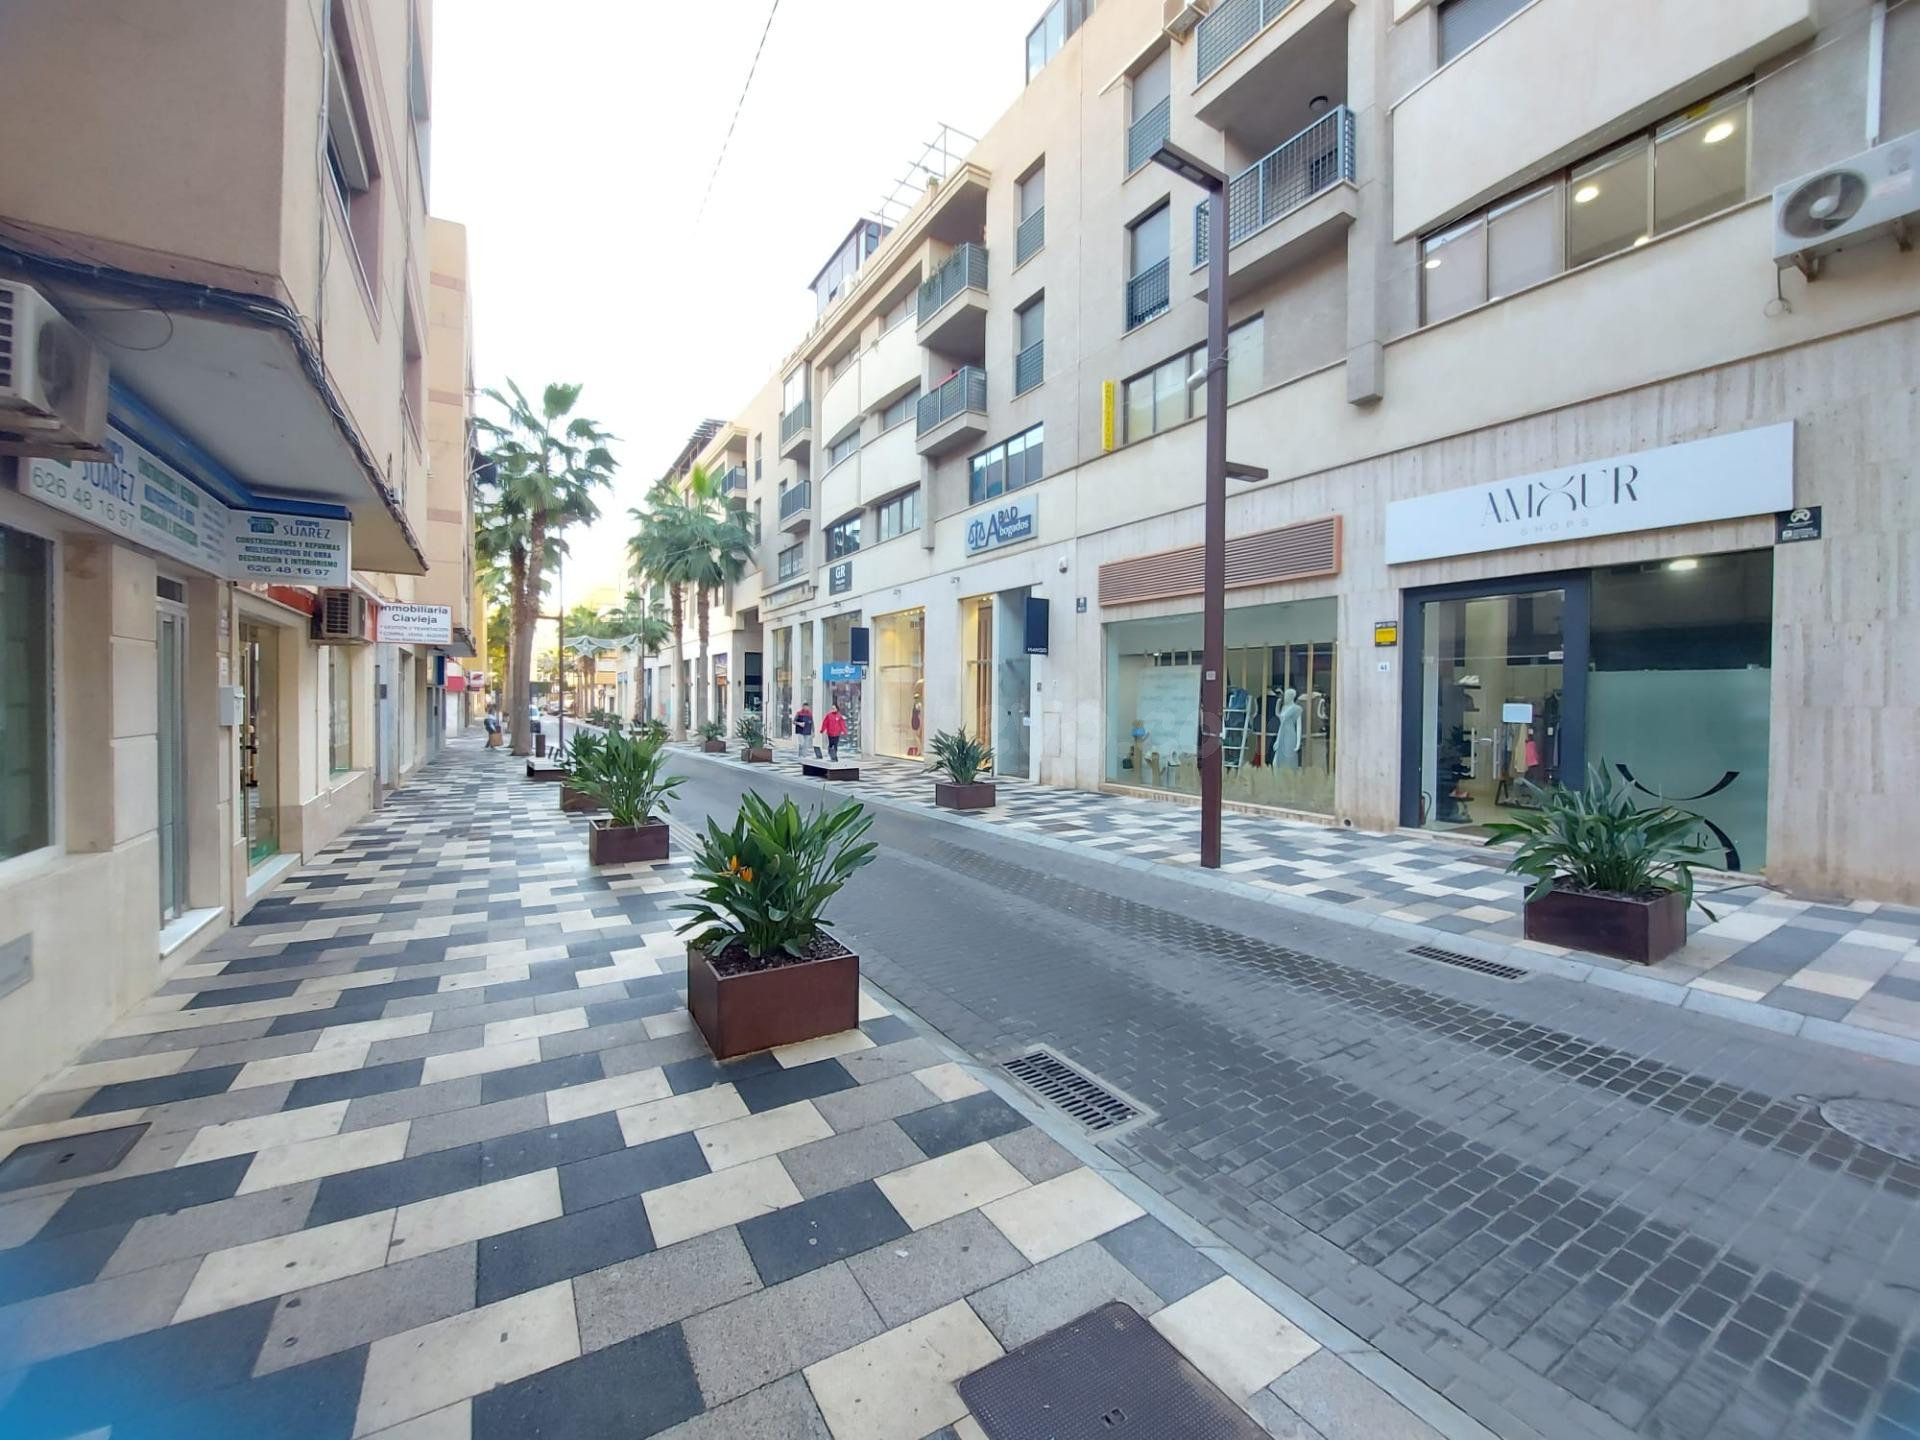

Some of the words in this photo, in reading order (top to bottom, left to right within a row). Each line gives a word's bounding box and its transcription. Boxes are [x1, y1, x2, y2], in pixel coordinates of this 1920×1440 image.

[33, 466, 67, 499] 626
[73, 487, 92, 510] 48
[99, 499, 115, 521] 16
[120, 509, 135, 528] 97
[1520, 518, 1589, 535] SHOPS
[247, 564, 271, 572] 626
[275, 565, 291, 573] 48
[297, 567, 311, 575] 16
